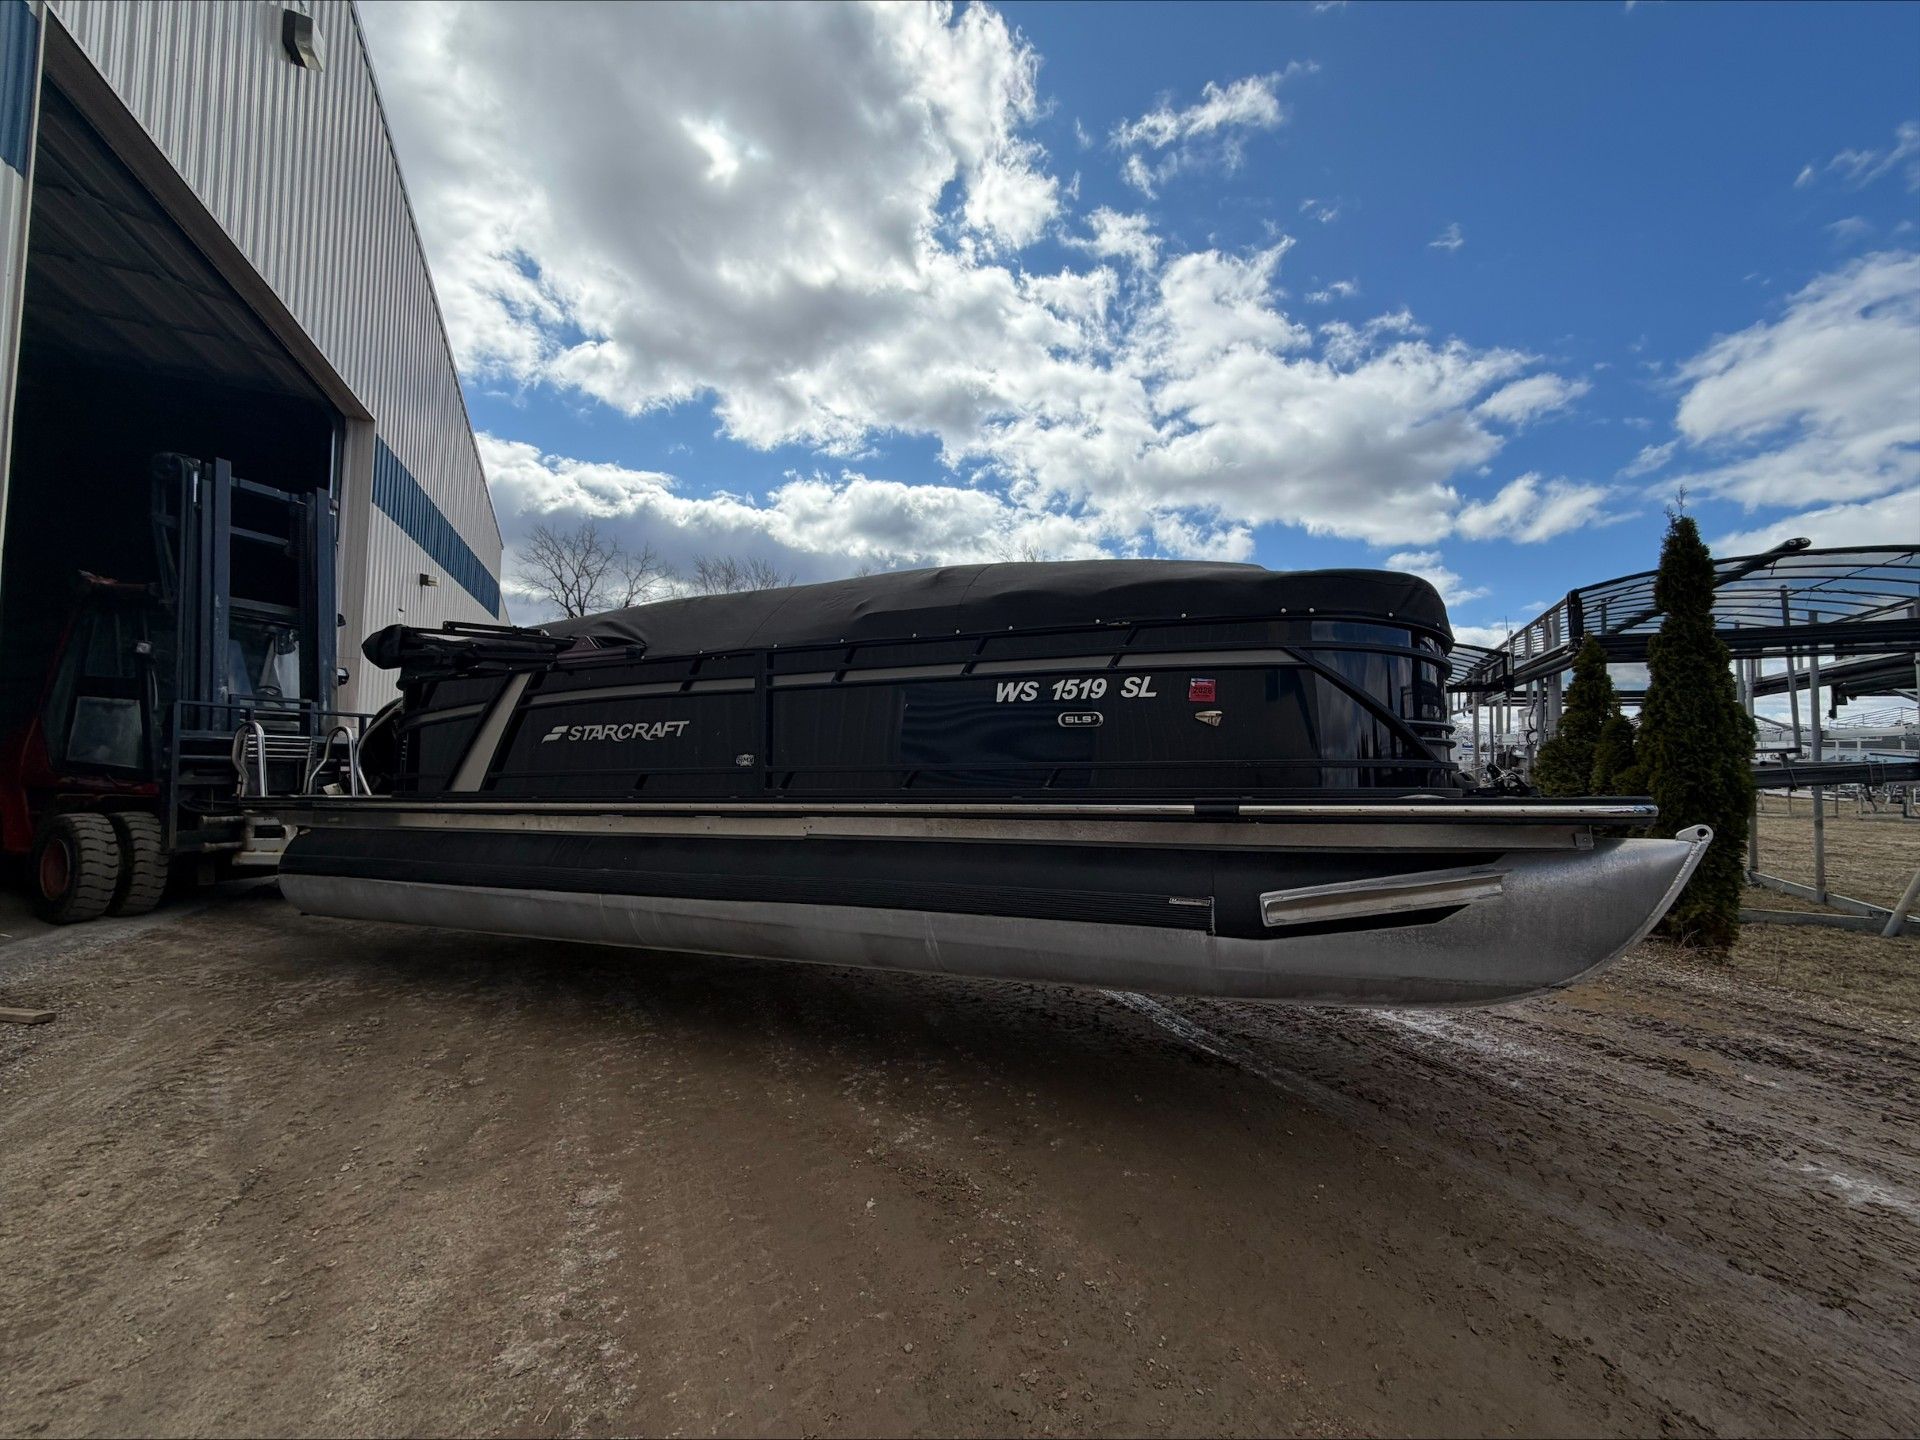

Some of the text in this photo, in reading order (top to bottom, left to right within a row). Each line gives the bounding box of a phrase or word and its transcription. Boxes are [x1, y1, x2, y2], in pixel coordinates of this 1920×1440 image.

[996, 676, 1157, 703] WS 1519 SL
[568, 720, 690, 742] STARCRAFT
